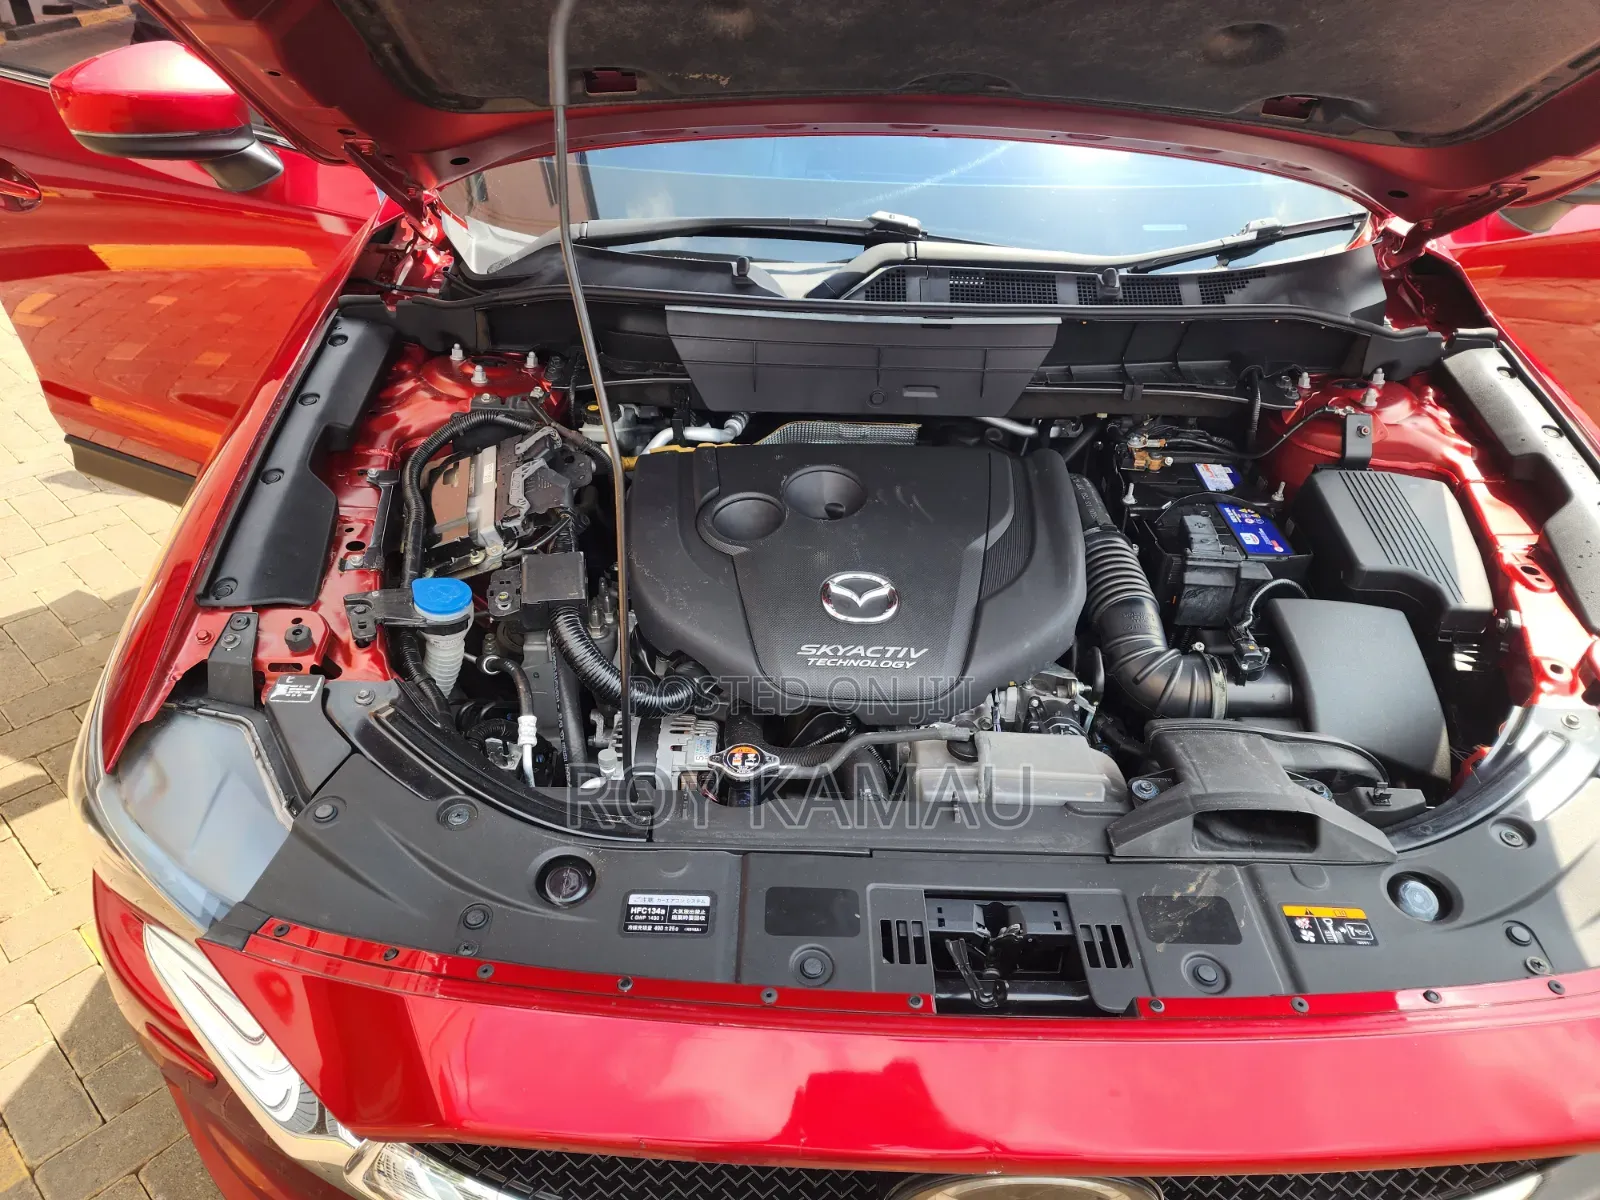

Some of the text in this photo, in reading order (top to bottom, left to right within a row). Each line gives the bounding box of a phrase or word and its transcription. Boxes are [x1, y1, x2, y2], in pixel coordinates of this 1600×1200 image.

[797, 644, 929, 659] SKYACTIV
[807, 658, 917, 669] TECHNOLOGY
[630, 907, 666, 915] HFC134a
